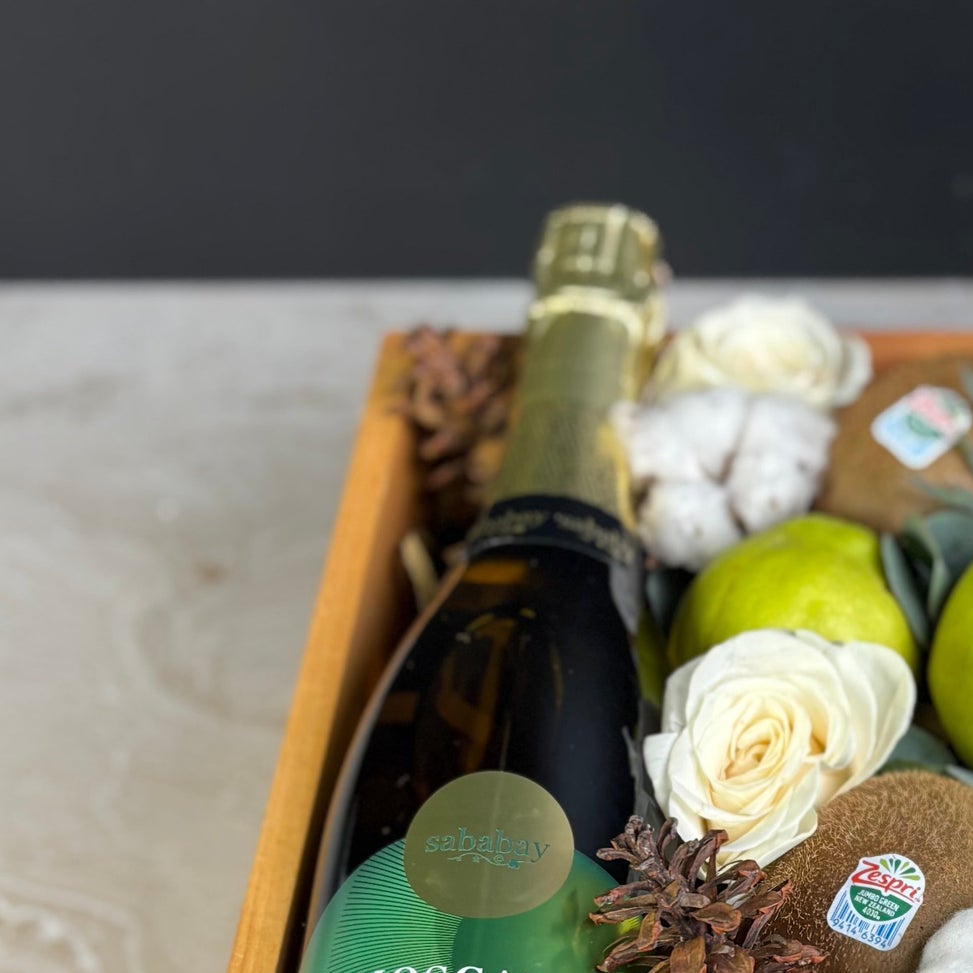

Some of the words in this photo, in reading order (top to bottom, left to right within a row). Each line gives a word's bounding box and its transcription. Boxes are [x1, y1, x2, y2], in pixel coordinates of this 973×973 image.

[424, 826, 550, 863] sababay
[851, 860, 921, 901] Zespri
[854, 894, 869, 905] NEW
[868, 900, 895, 917] ZEALAND
[857, 889, 880, 902] JUMBO
[879, 897, 900, 911] GREEN
